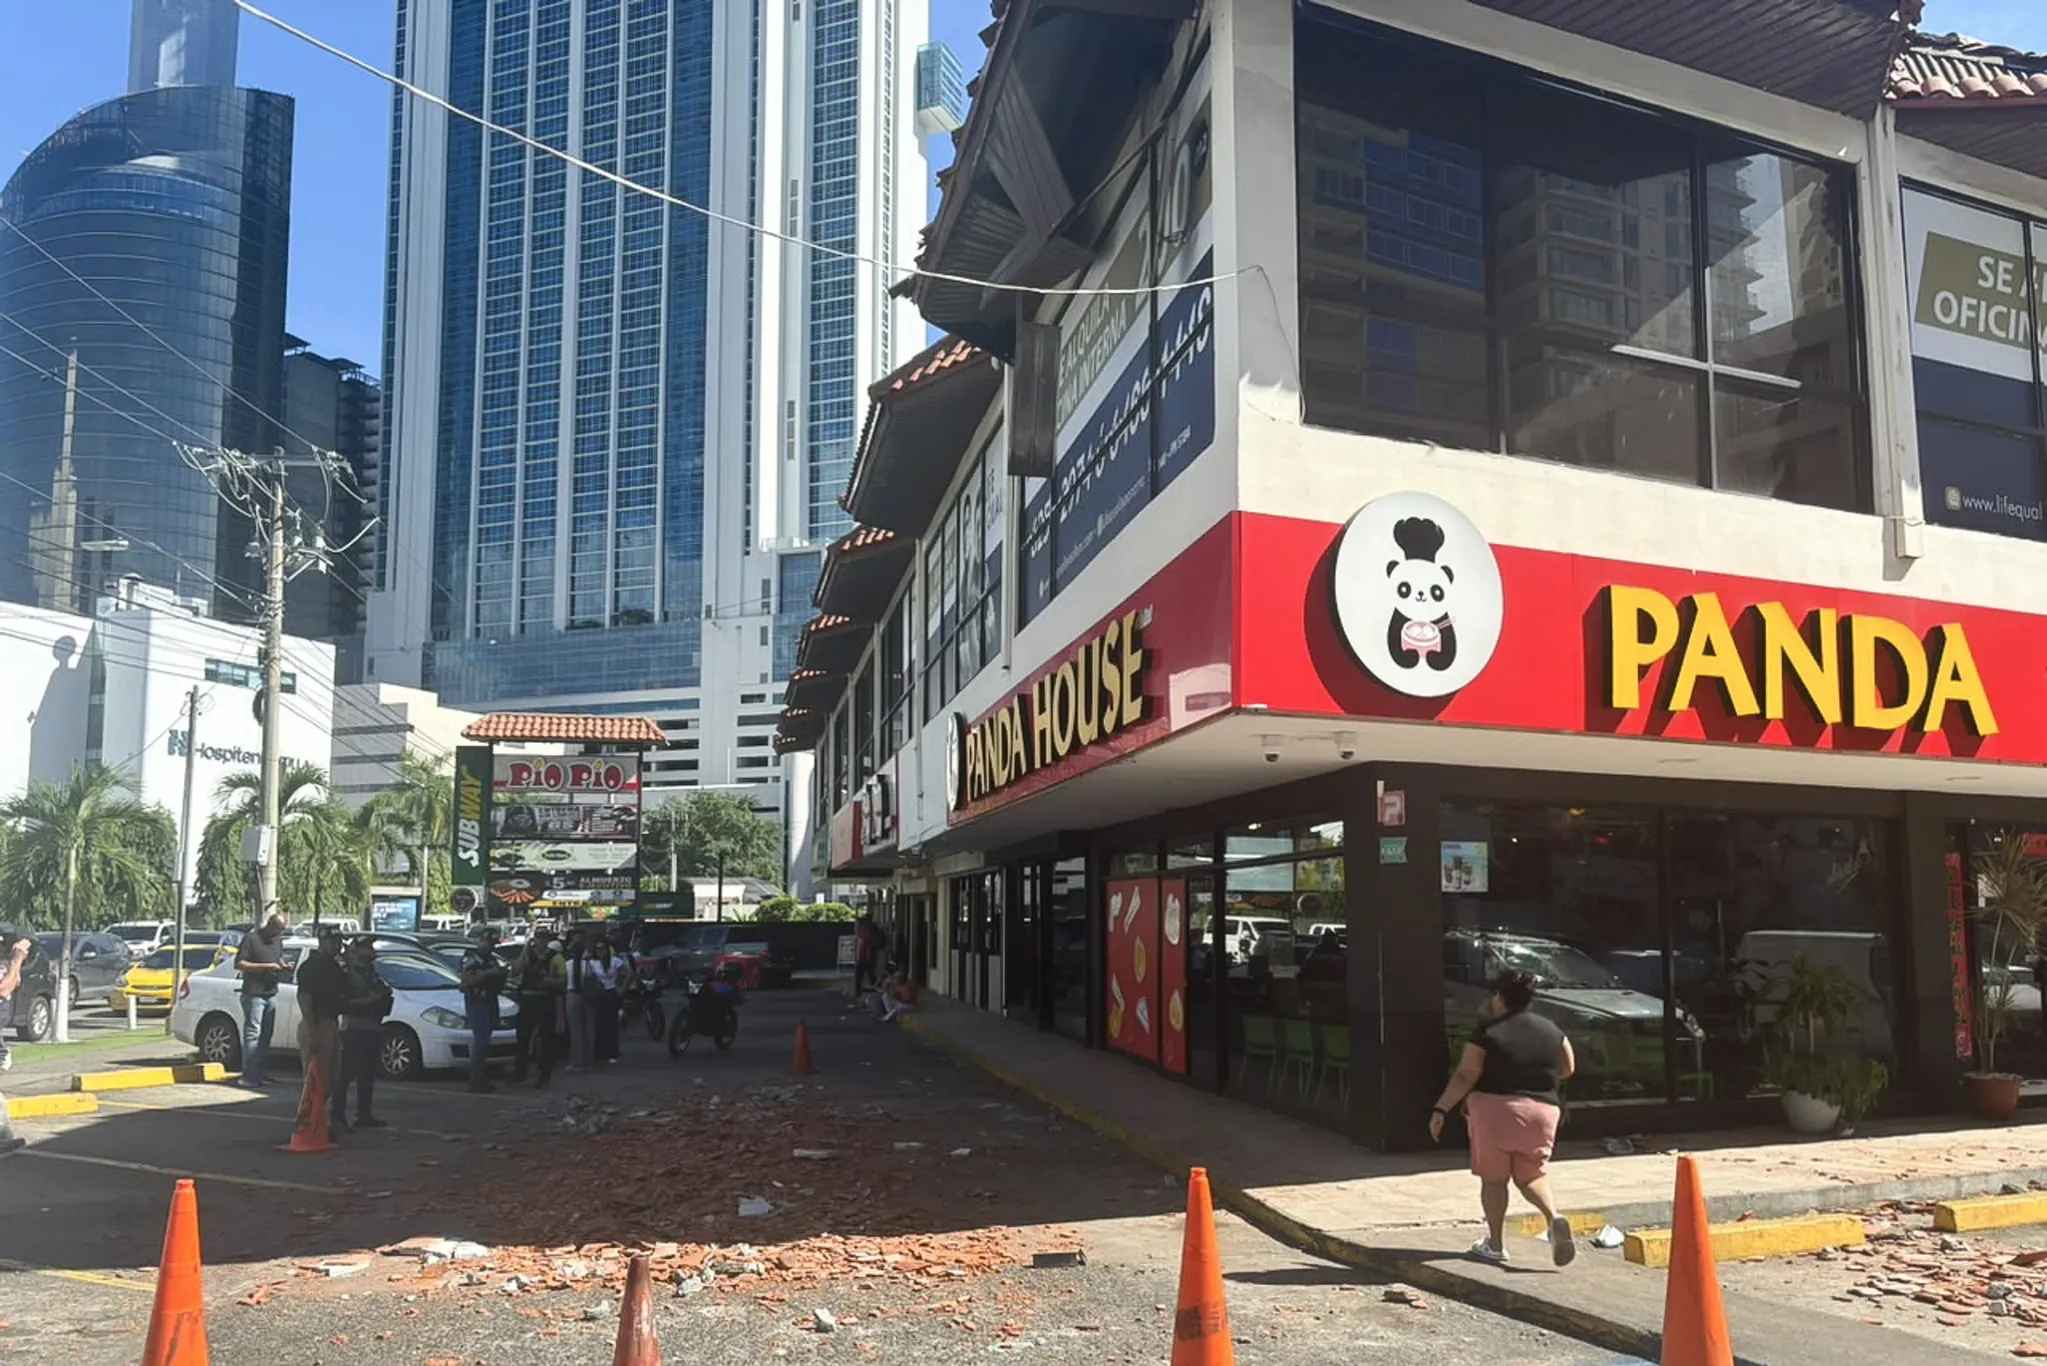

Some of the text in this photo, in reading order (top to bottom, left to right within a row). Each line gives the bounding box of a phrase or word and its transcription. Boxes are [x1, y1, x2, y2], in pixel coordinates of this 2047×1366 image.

[1978, 256, 2013, 294] SE
[966, 608, 1143, 803] PANDA HOUSE
[1610, 584, 1999, 737] PANDA
[458, 764, 482, 869] SUBWAY
